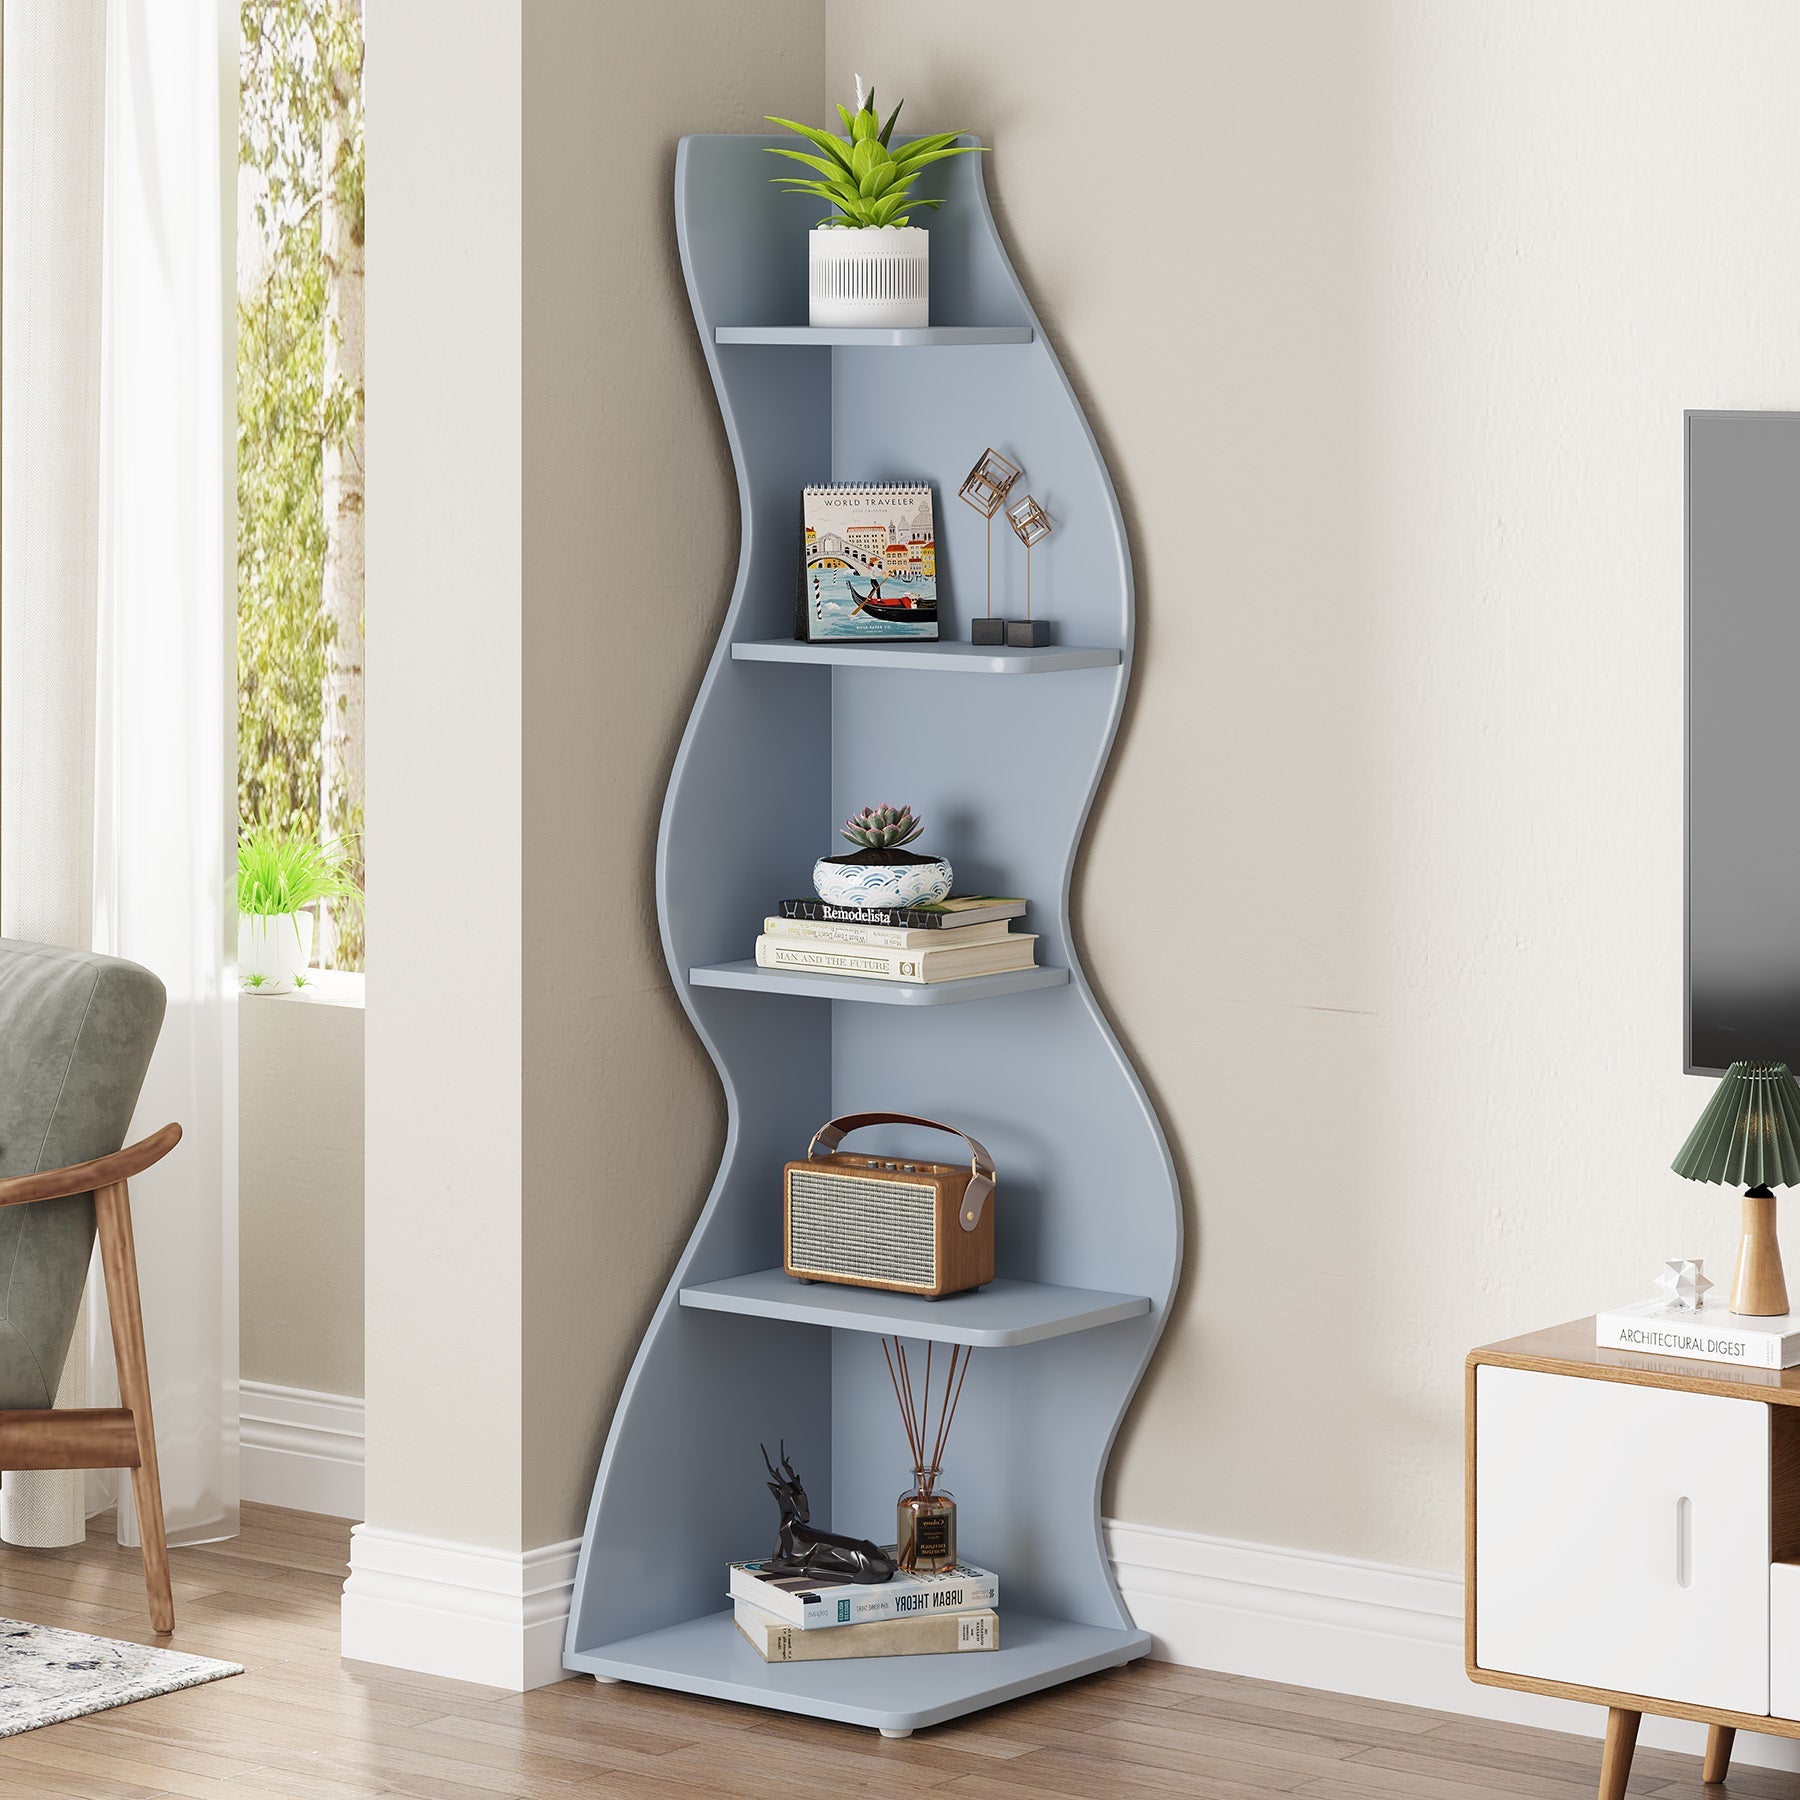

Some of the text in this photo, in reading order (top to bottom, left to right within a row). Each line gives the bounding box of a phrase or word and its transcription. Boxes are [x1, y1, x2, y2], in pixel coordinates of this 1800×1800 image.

[824, 498, 914, 507] WORLD TRAVELER
[823, 905, 891, 923] Remodelista
[776, 952, 799, 961] MAN
[802, 954, 823, 964] AND
[826, 956, 847, 966] THE
[850, 958, 890, 972] FUTURE
[1619, 1328, 1704, 1352] ARCHITECTURAL
[1707, 1339, 1746, 1357] DIGEST
